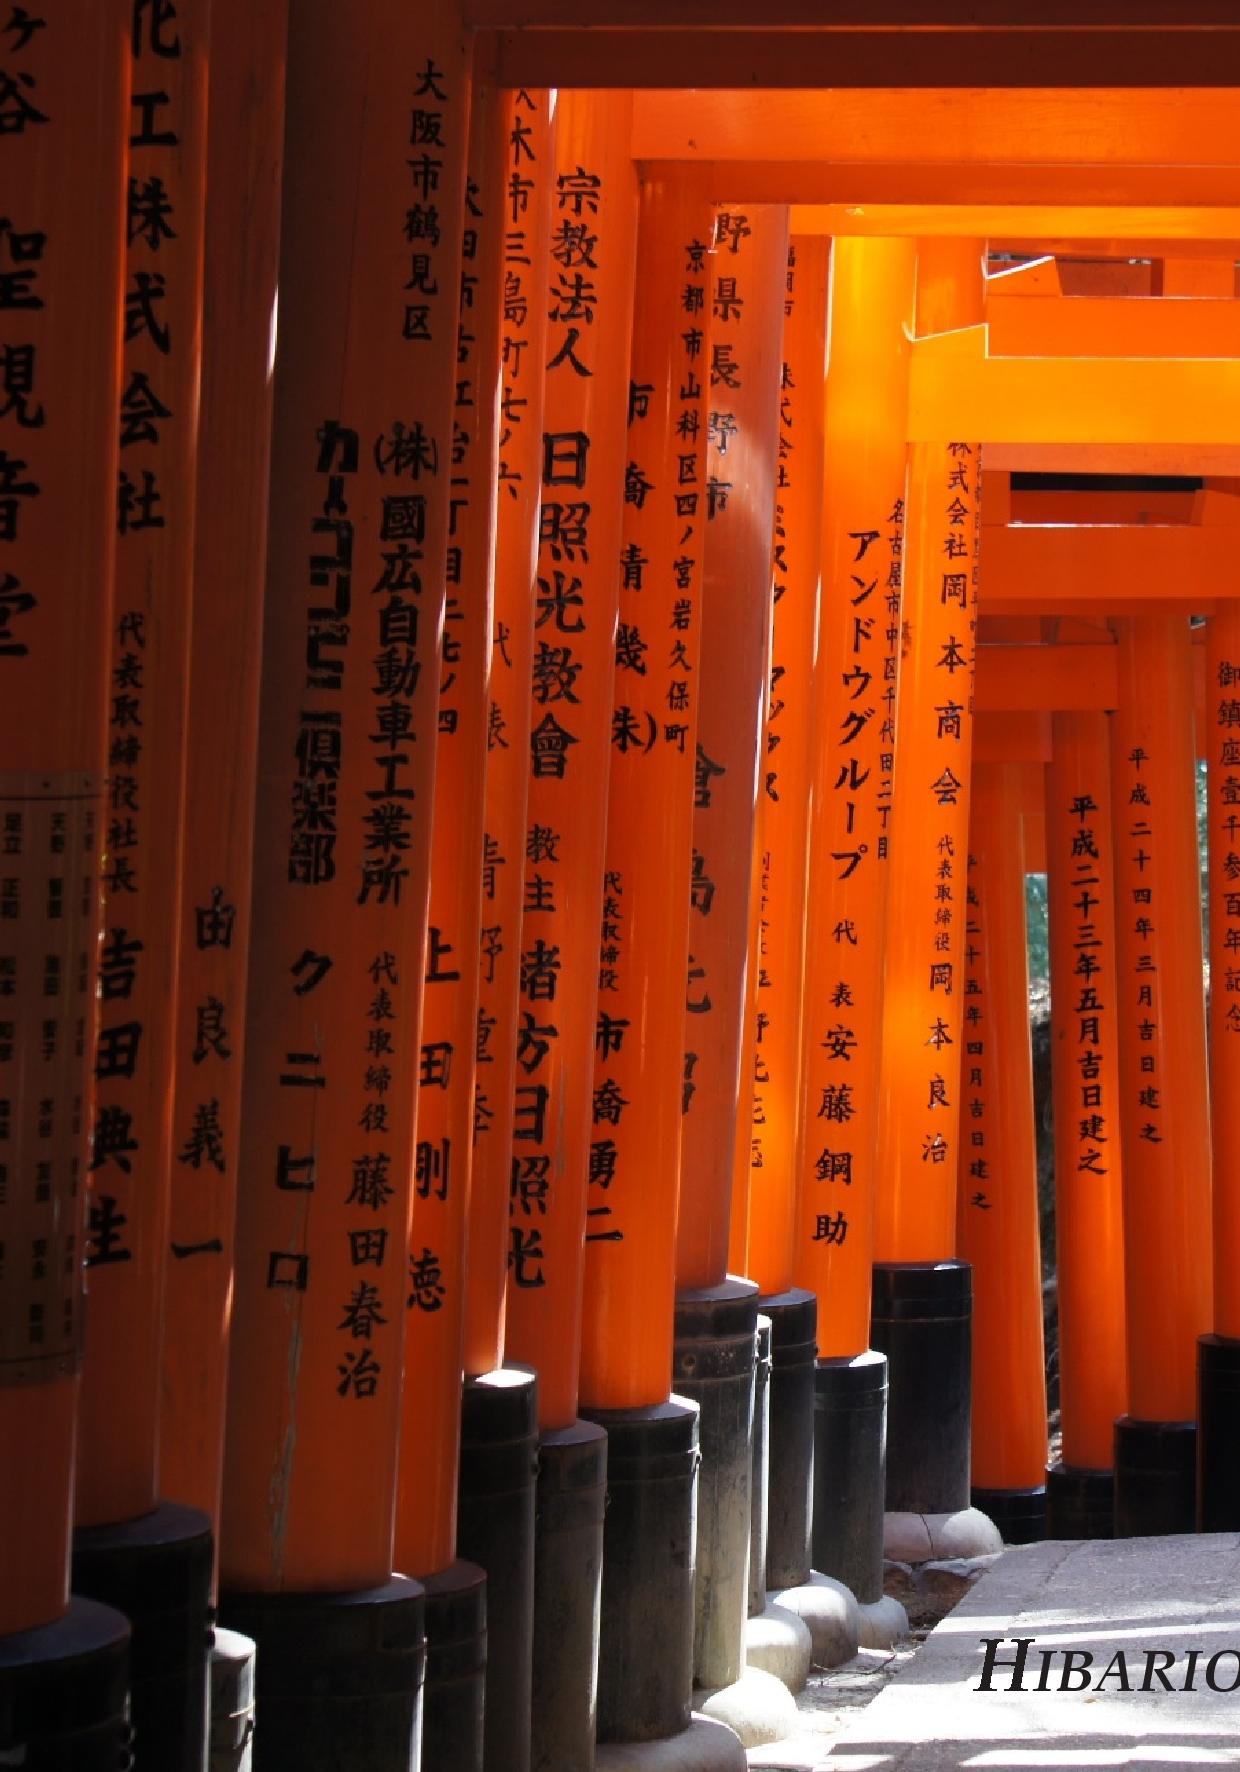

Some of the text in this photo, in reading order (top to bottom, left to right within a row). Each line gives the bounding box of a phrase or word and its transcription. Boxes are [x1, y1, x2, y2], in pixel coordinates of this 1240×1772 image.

[401, 58, 449, 342] 大阪市鶴見区
[547, 166, 602, 378] 宗教法人
[830, 530, 881, 880] アンドウグループ
[1068, 795, 1109, 1177] 平成二十三年五月吉日建之
[1128, 746, 1163, 1144] 平成二十四年三月吉日建之
